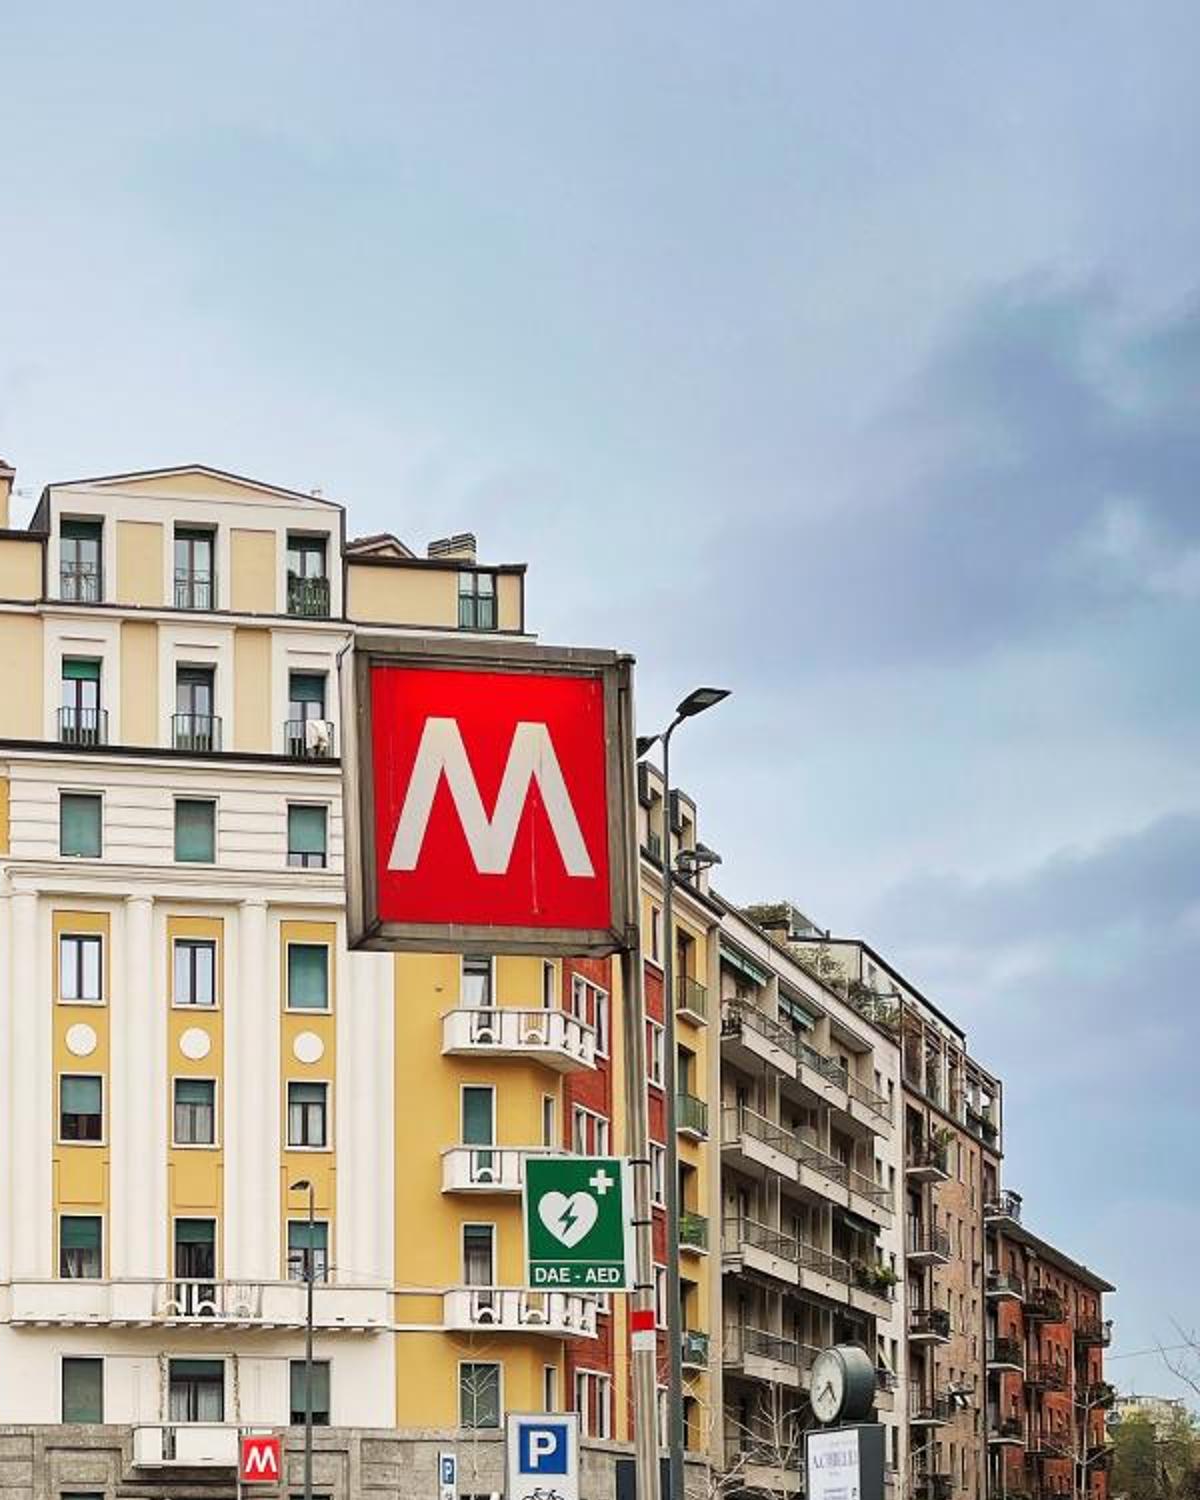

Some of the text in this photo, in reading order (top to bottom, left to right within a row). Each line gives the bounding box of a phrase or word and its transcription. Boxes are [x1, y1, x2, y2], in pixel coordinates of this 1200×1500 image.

[387, 717, 596, 878] M
[535, 1267, 571, 1283] DAE
[585, 1267, 620, 1283] AED
[245, 1446, 278, 1473] M
[529, 1430, 557, 1469] P
